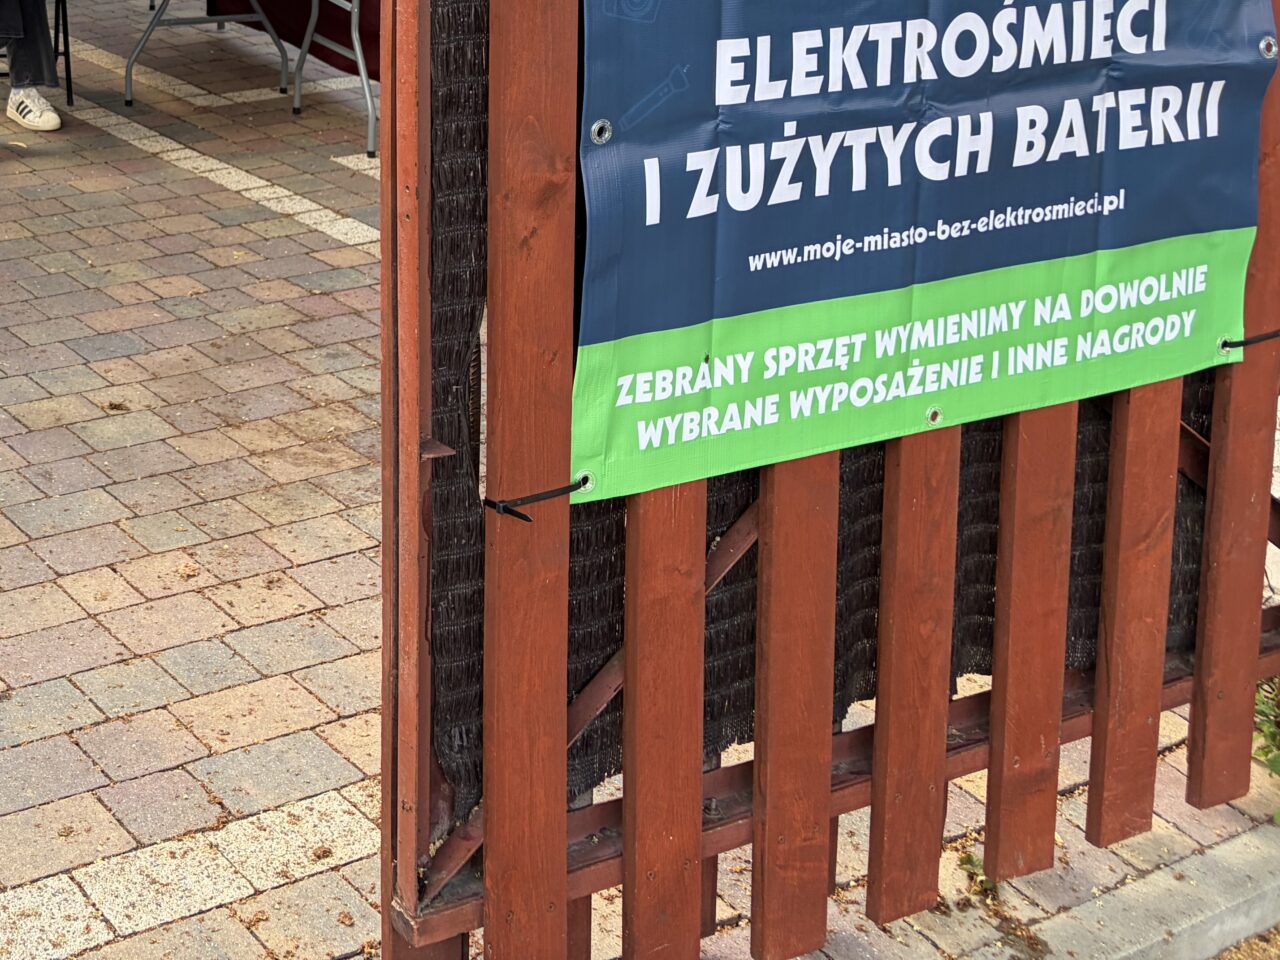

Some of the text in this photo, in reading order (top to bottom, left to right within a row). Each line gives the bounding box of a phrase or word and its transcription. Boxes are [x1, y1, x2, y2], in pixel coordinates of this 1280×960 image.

[643, 80, 1227, 226] I ZUŻYTYCH BATERII
[747, 189, 1125, 272] www.moje-miasto-bez-elektrosmieci.pl
[616, 265, 1208, 406] ZEBRANY SPRZĘT WYMIENIMY NA DOWOLNIE
[636, 310, 1197, 451] WYBRANE WYPOSAŻENIE I INNE NAGRODY
